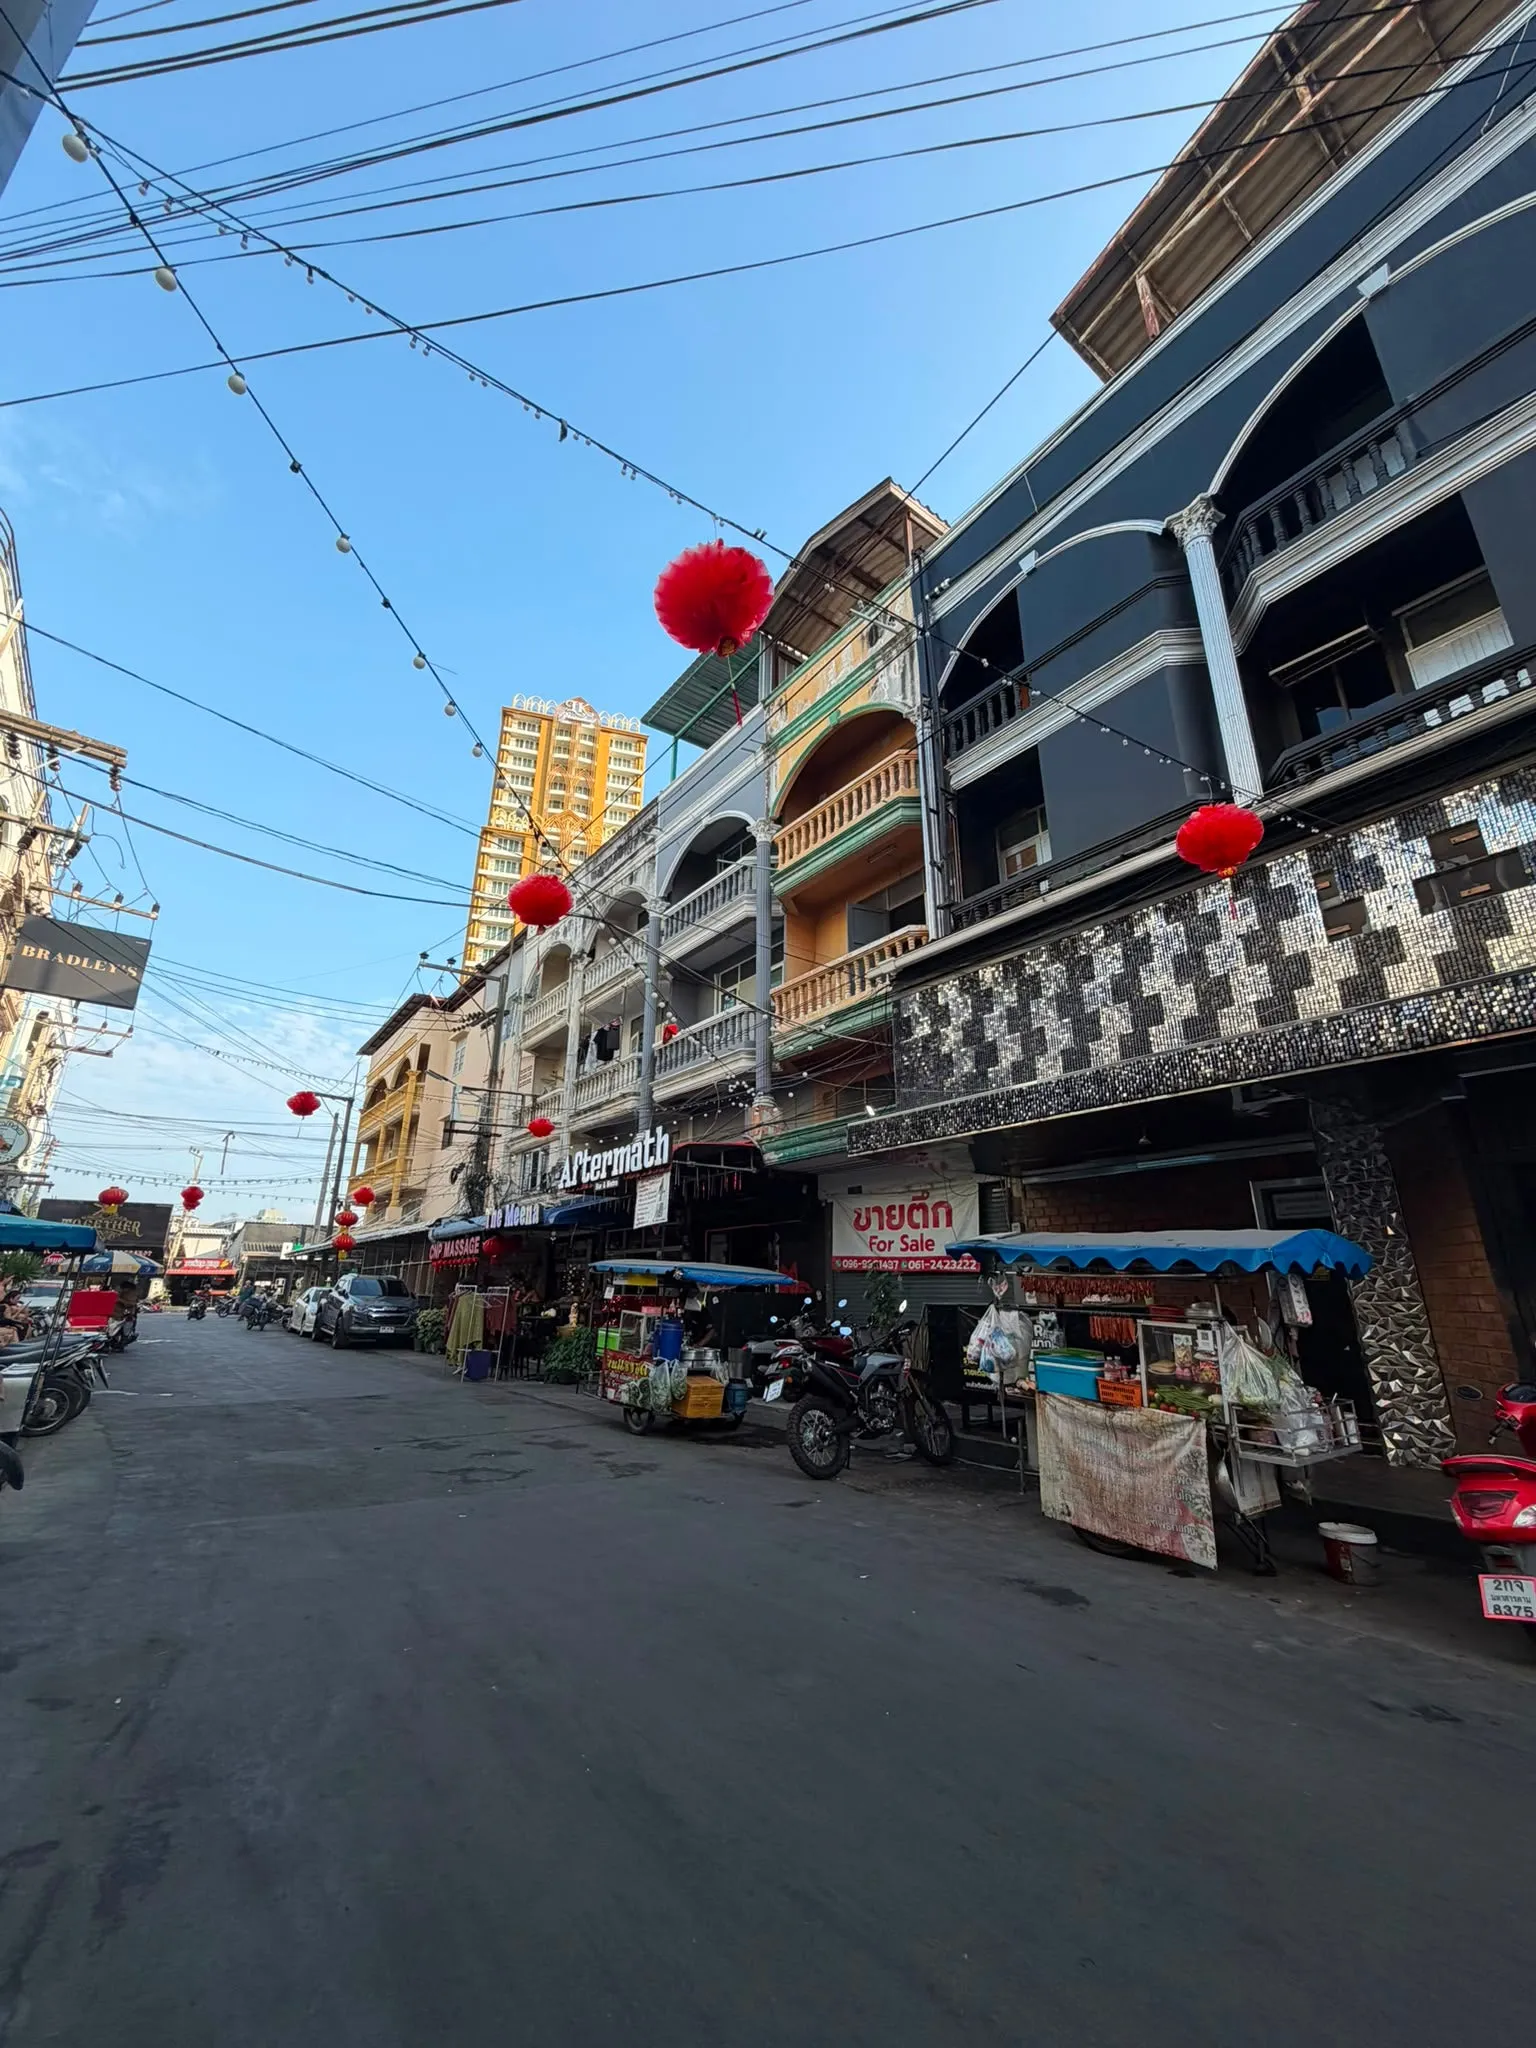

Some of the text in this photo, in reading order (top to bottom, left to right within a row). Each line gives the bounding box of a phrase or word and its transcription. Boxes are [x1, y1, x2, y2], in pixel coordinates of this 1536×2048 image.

[21, 945, 138, 978] BRADLEY'S
[558, 1125, 670, 1190] Aftermath
[485, 1203, 540, 1229] The Meena
[853, 1191, 953, 1231] ขายตึก
[443, 1236, 480, 1258] MASSAGE
[869, 1233, 935, 1252] For Sale
[908, 1259, 977, 1270] 061-2423222
[1492, 1604, 1534, 1618] 8375
